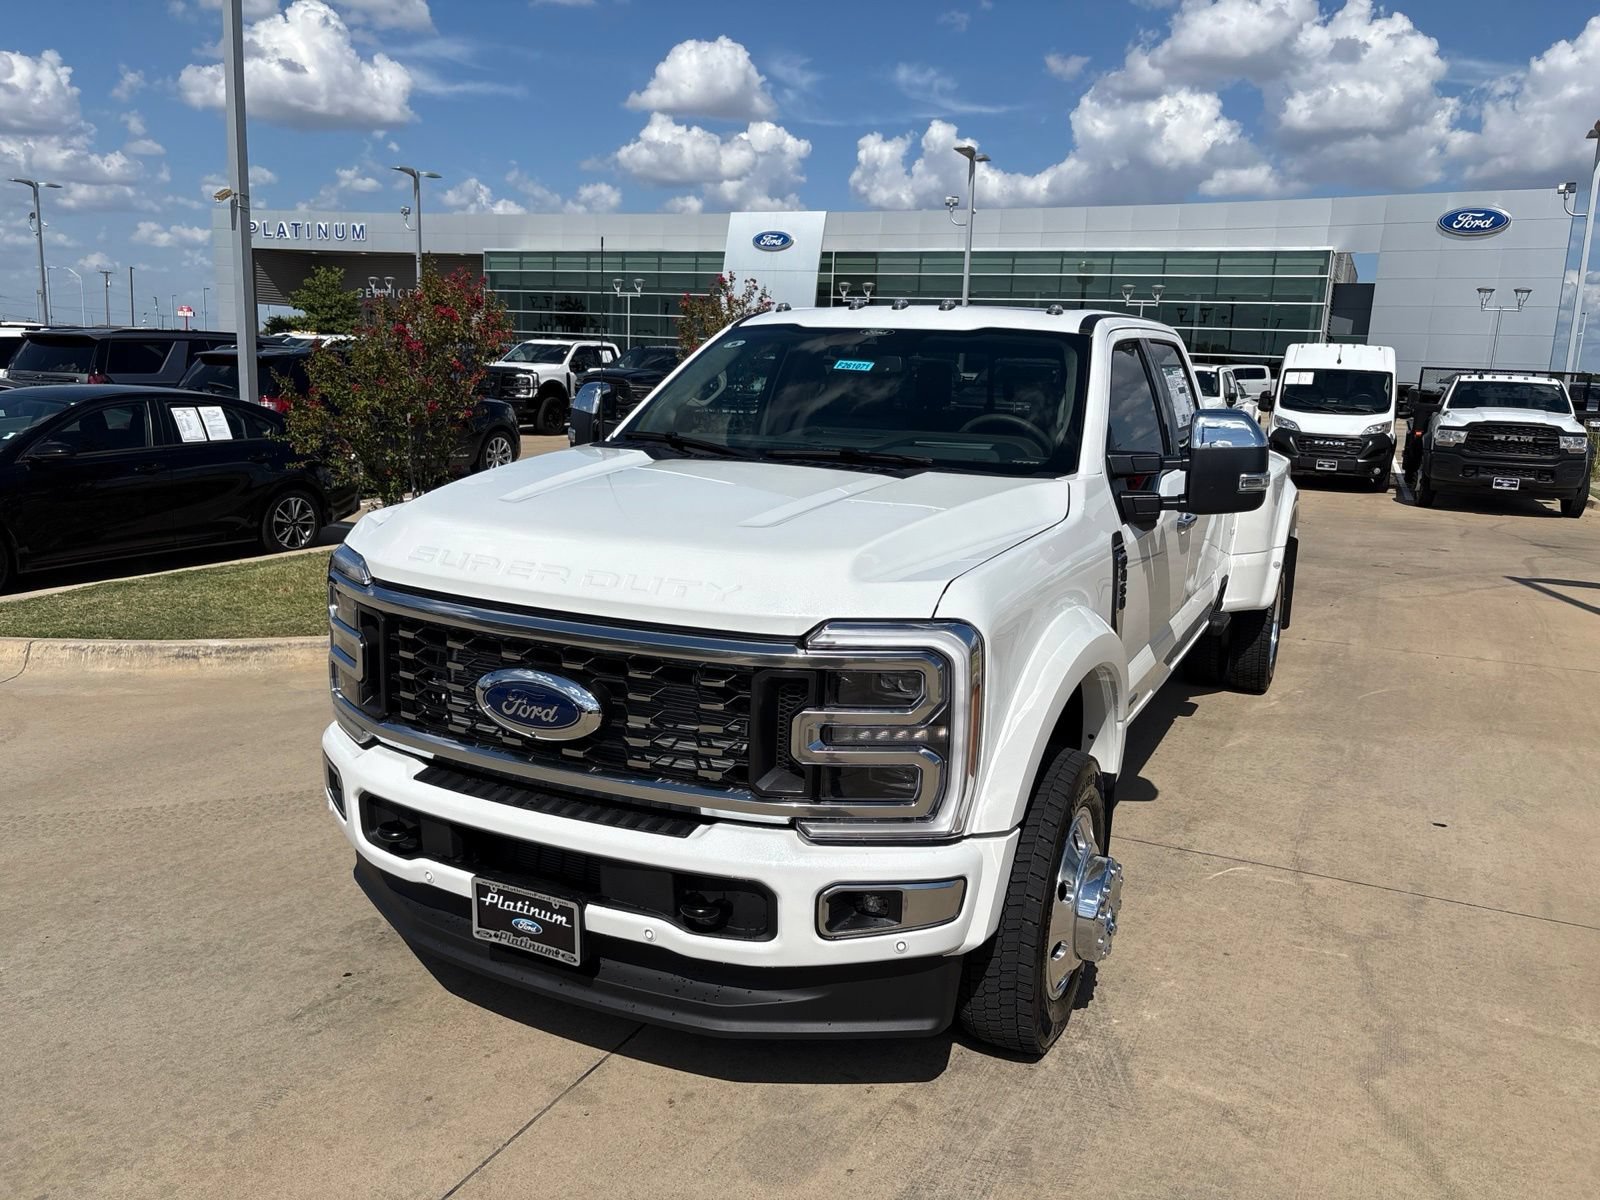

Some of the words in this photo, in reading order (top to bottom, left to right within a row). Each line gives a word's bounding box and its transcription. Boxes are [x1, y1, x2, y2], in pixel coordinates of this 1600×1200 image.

[1452, 212, 1496, 229] Ford
[760, 234, 784, 246] Ford
[1493, 434, 1534, 442] RAM
[405, 544, 572, 583] SUPER
[580, 568, 743, 602] DUTY
[501, 688, 560, 723] Ford
[480, 892, 573, 928] Platinum
[517, 920, 537, 933] Ford
[498, 930, 560, 958] Platinum
